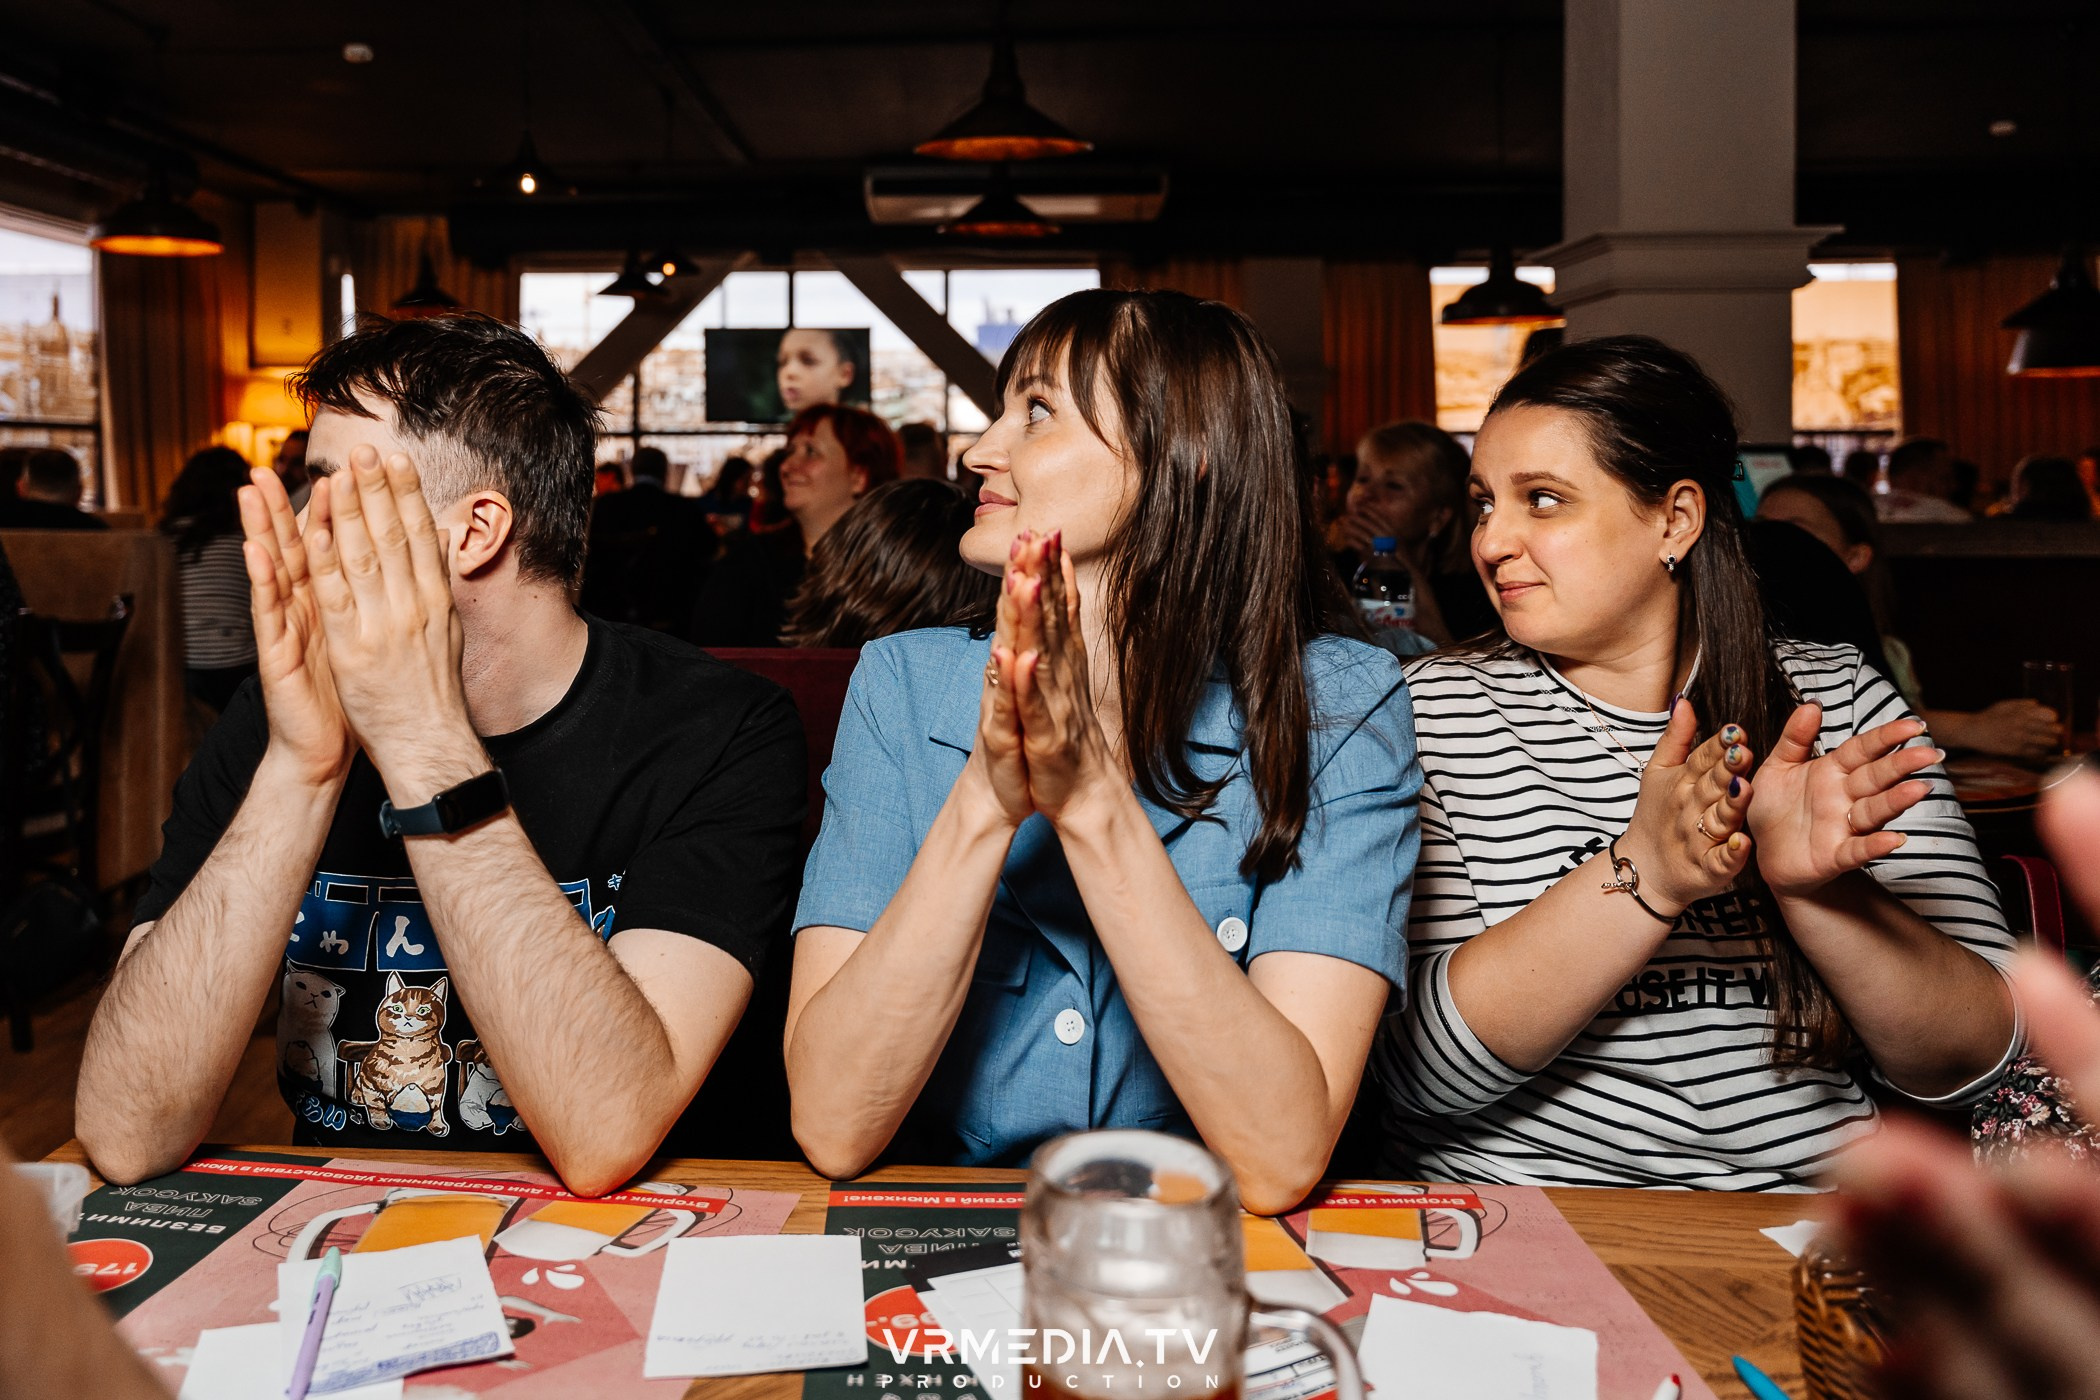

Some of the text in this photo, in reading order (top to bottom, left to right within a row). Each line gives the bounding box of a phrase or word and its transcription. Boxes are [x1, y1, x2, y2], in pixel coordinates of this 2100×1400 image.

[254, 1166, 376, 1182] удовольствий
[377, 1177, 505, 1192] безграничных
[508, 1186, 544, 1194] дни
[108, 1186, 263, 1206] ЗАКУСОК
[631, 1195, 710, 1209] Вторник
[843, 1194, 940, 1204] Мюнхене!
[1324, 1197, 1360, 1206] сре
[1380, 1196, 1466, 1206] Вторник
[124, 1201, 214, 1218] ПИВА
[843, 1226, 1016, 1238] ЗАКУСОК
